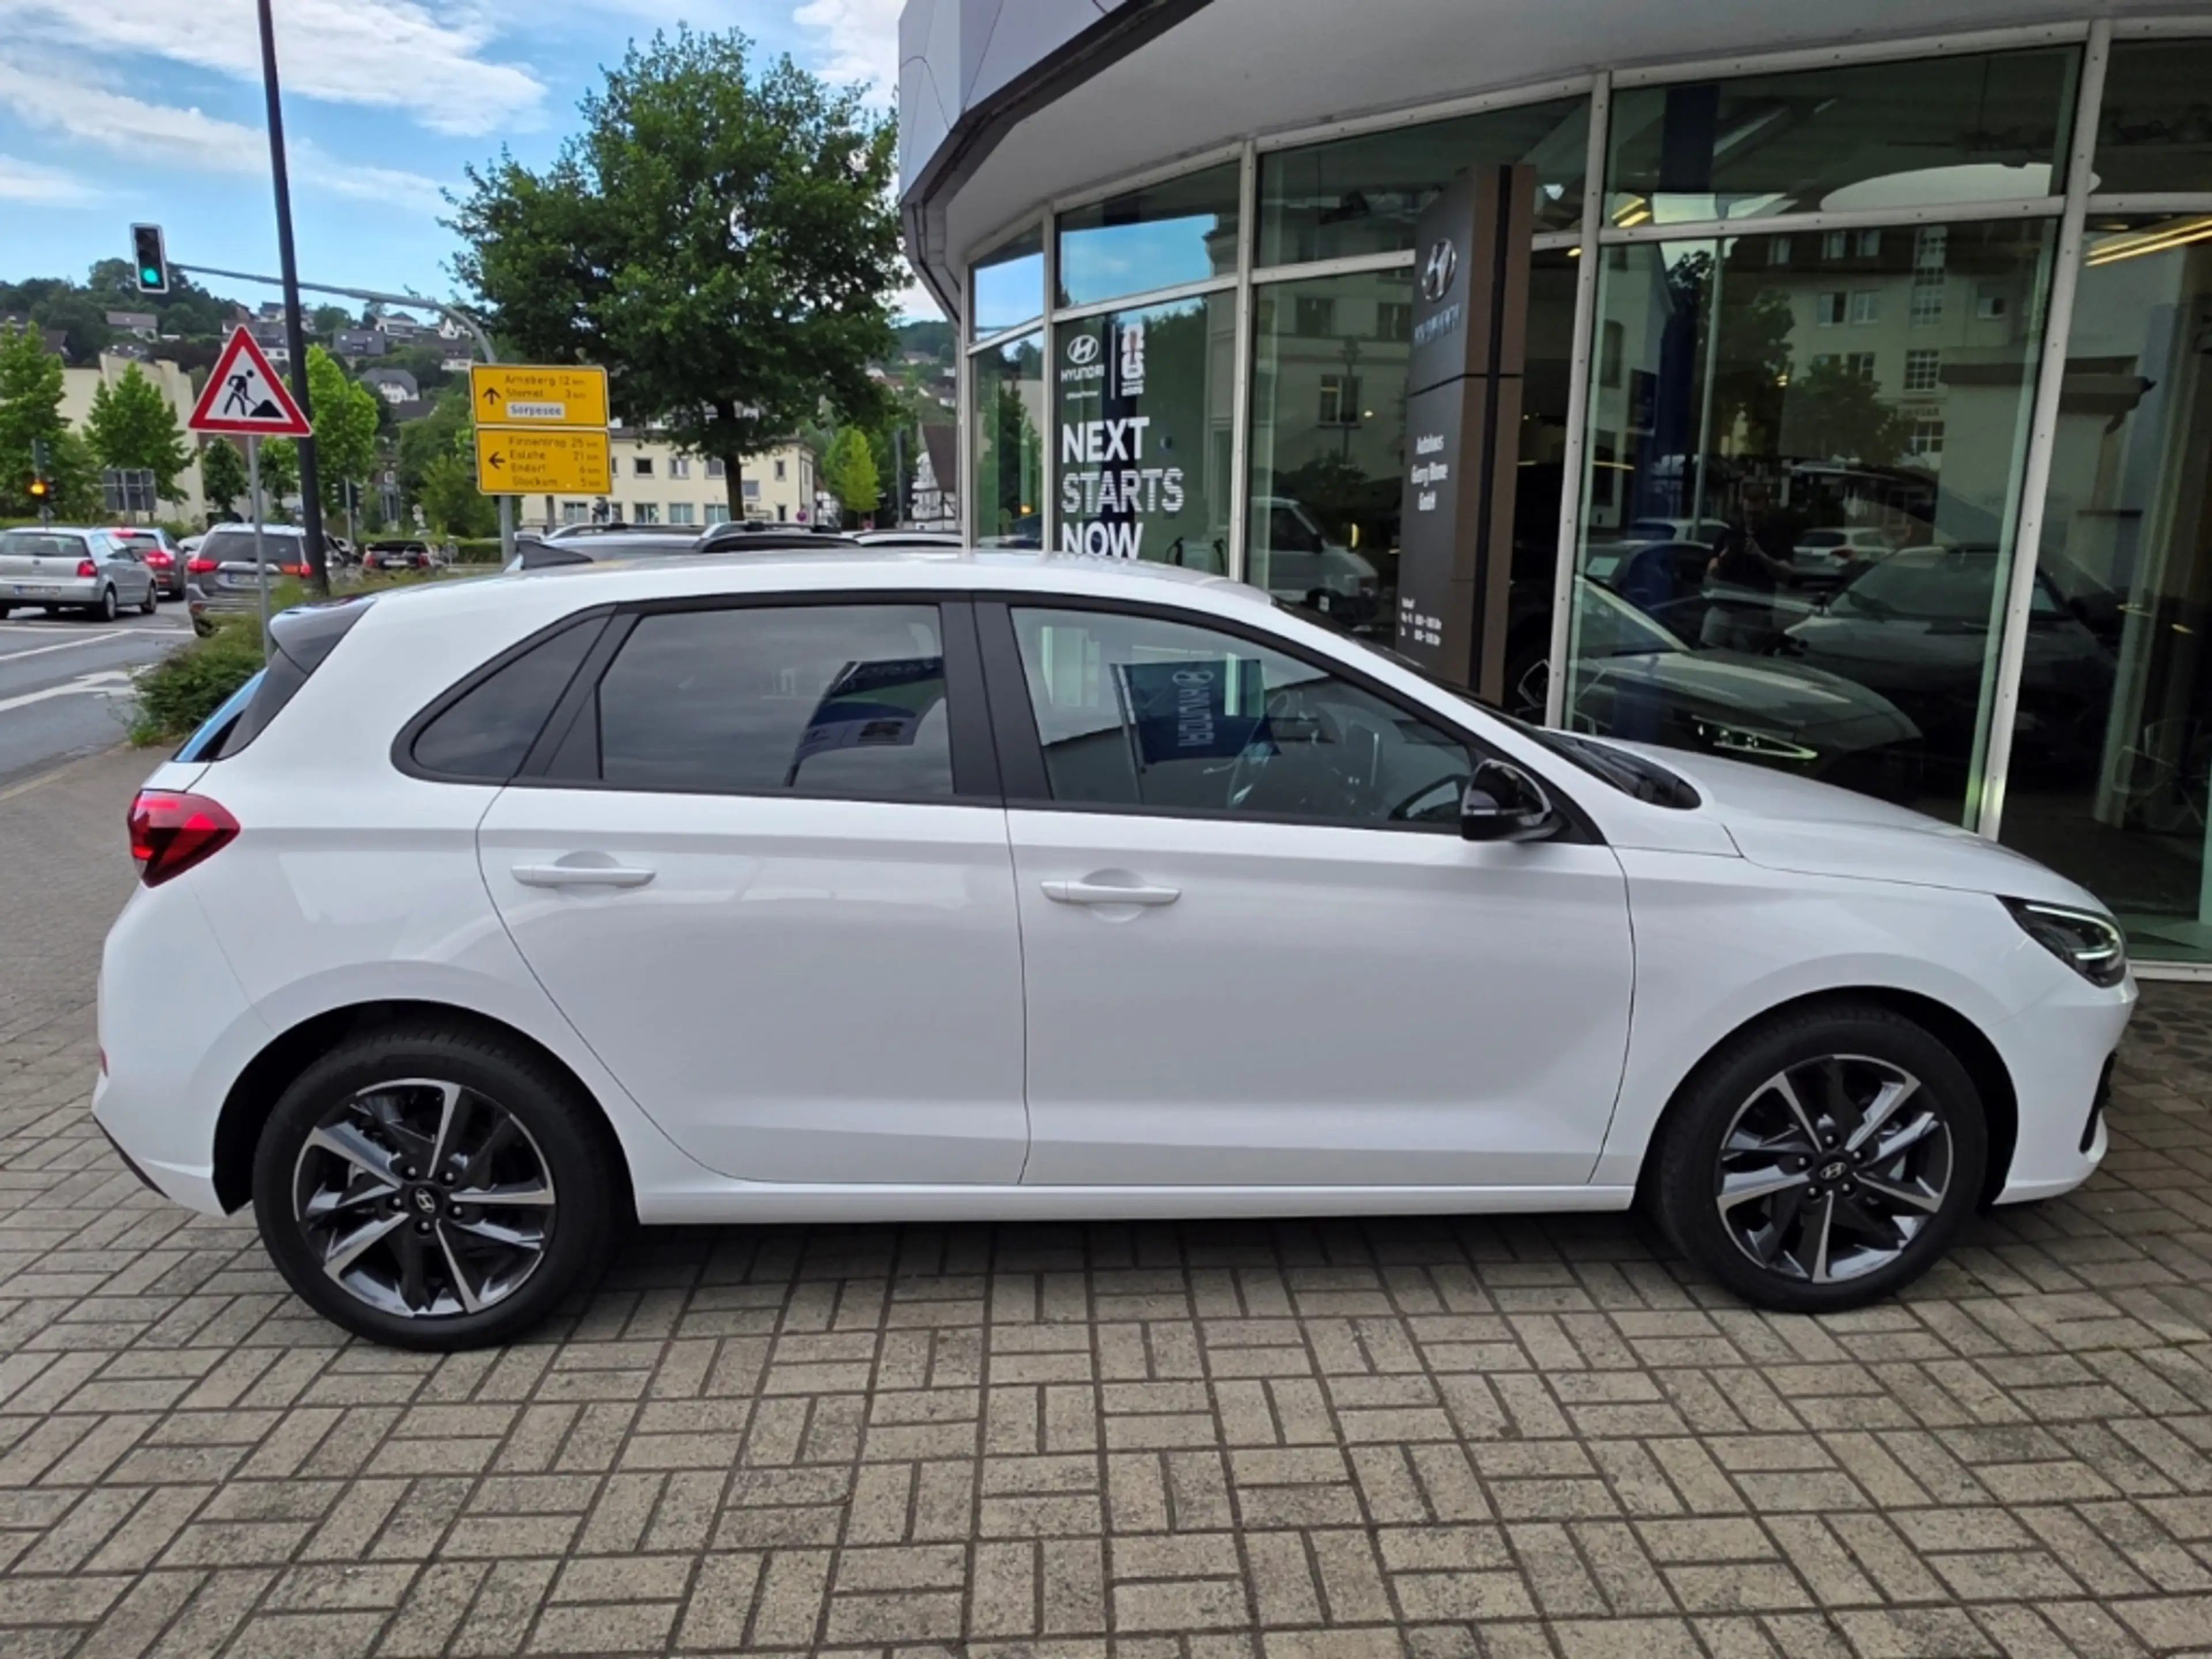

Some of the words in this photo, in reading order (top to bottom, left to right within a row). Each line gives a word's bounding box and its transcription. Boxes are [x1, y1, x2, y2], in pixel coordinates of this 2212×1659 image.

[505, 374, 556, 387] Arnsberg
[1060, 364, 1104, 383] HYUNDAI
[510, 404, 562, 416] Sorpesee
[1062, 416, 1149, 463] NEXT
[1061, 468, 1184, 513] STARTS
[1062, 522, 1143, 560] NOW
